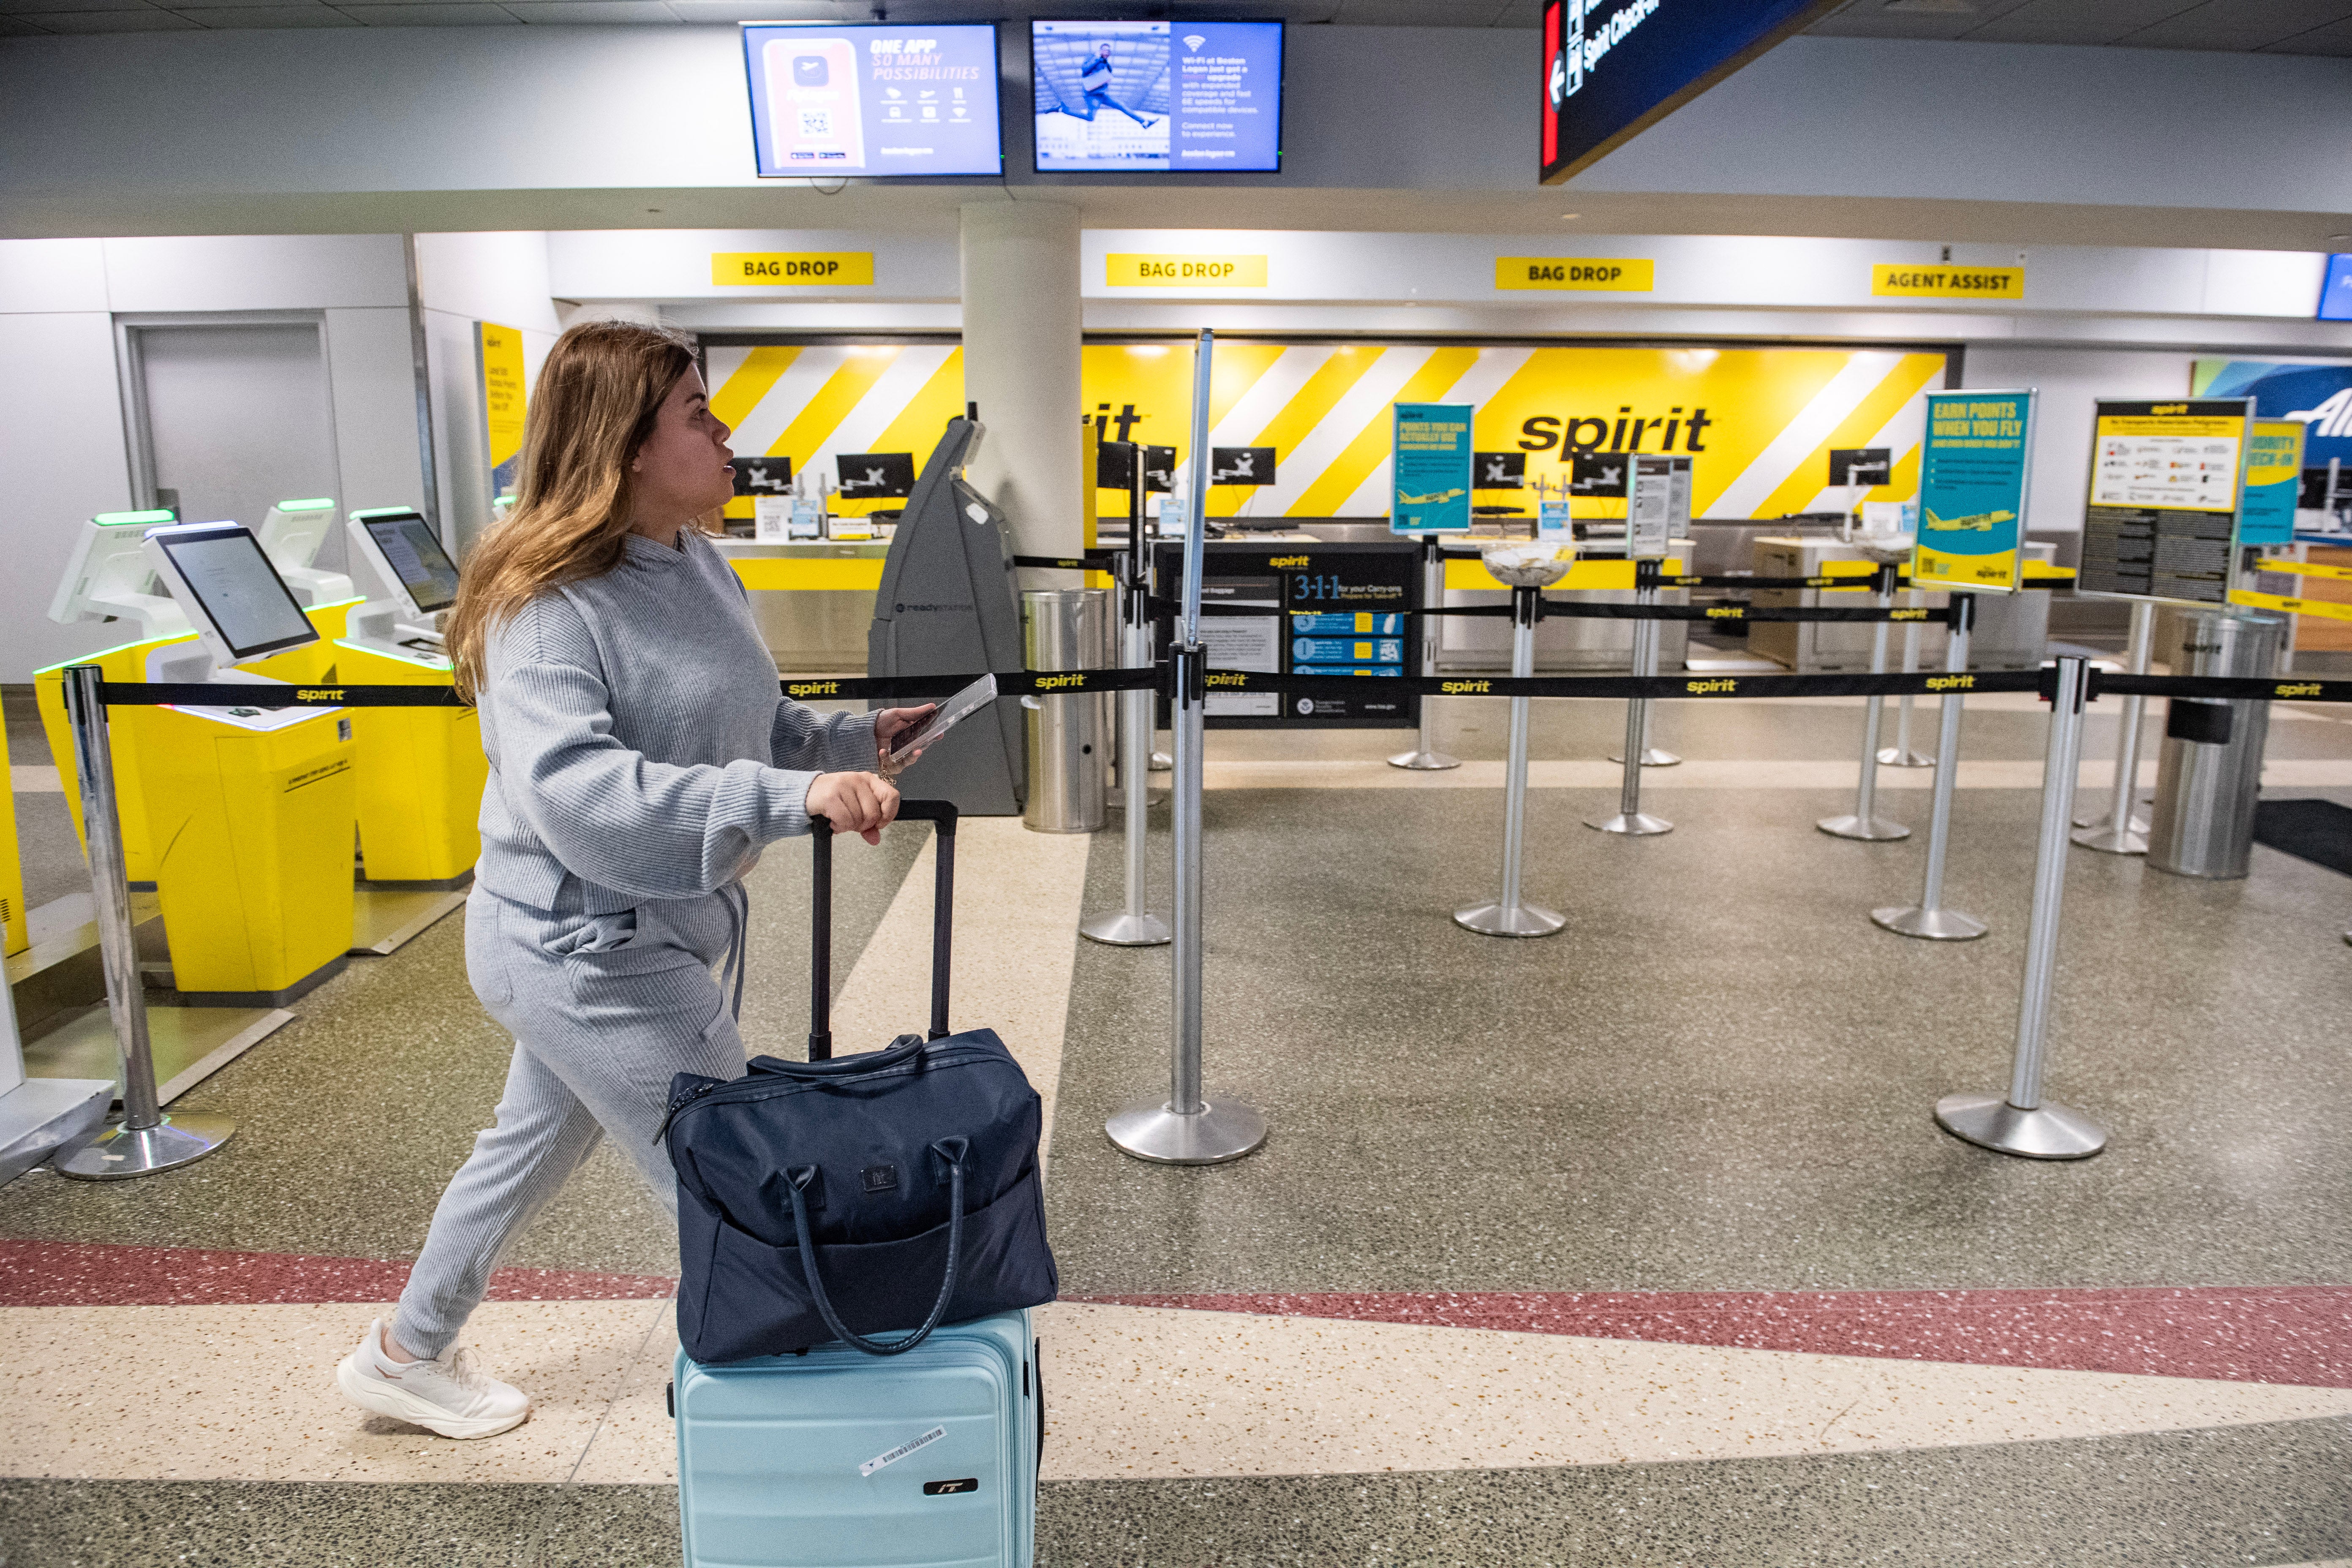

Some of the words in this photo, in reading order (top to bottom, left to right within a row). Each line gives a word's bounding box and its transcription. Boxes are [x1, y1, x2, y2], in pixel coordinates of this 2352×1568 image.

[870, 39, 903, 54] ONE
[903, 39, 937, 54] APP
[1584, 23, 1611, 73] Spirit
[871, 54, 892, 66] SO
[897, 54, 943, 66] MANY
[872, 66, 980, 80] POSSIBILITIES
[744, 261, 780, 276] BAG
[787, 260, 838, 276] DROP
[1140, 262, 1176, 277] BAG
[1182, 263, 1234, 277] DROP
[1528, 265, 1565, 280] BAG
[1570, 266, 1622, 281] DROP
[1886, 272, 1946, 288] AGENT
[1949, 274, 2011, 290] ASSIST
[1969, 402, 2016, 418] POINTS
[1518, 406, 1712, 461] spirit
[1933, 421, 1970, 436] WHEN
[1973, 421, 1998, 436] YOU
[2000, 420, 2022, 436] FLY
[1269, 556, 1309, 568] spirit
[1295, 575, 1340, 599] 3-1-1
[1707, 607, 1743, 619] spirit
[1890, 609, 1929, 621] spirit
[788, 681, 839, 697] spirit
[1035, 674, 1085, 689] spirit
[1441, 680, 1491, 694] spirit
[1687, 679, 1736, 694] spirit
[1926, 675, 1975, 690] spirit
[297, 689, 345, 702] spirit
[2275, 683, 2322, 697] spirit
